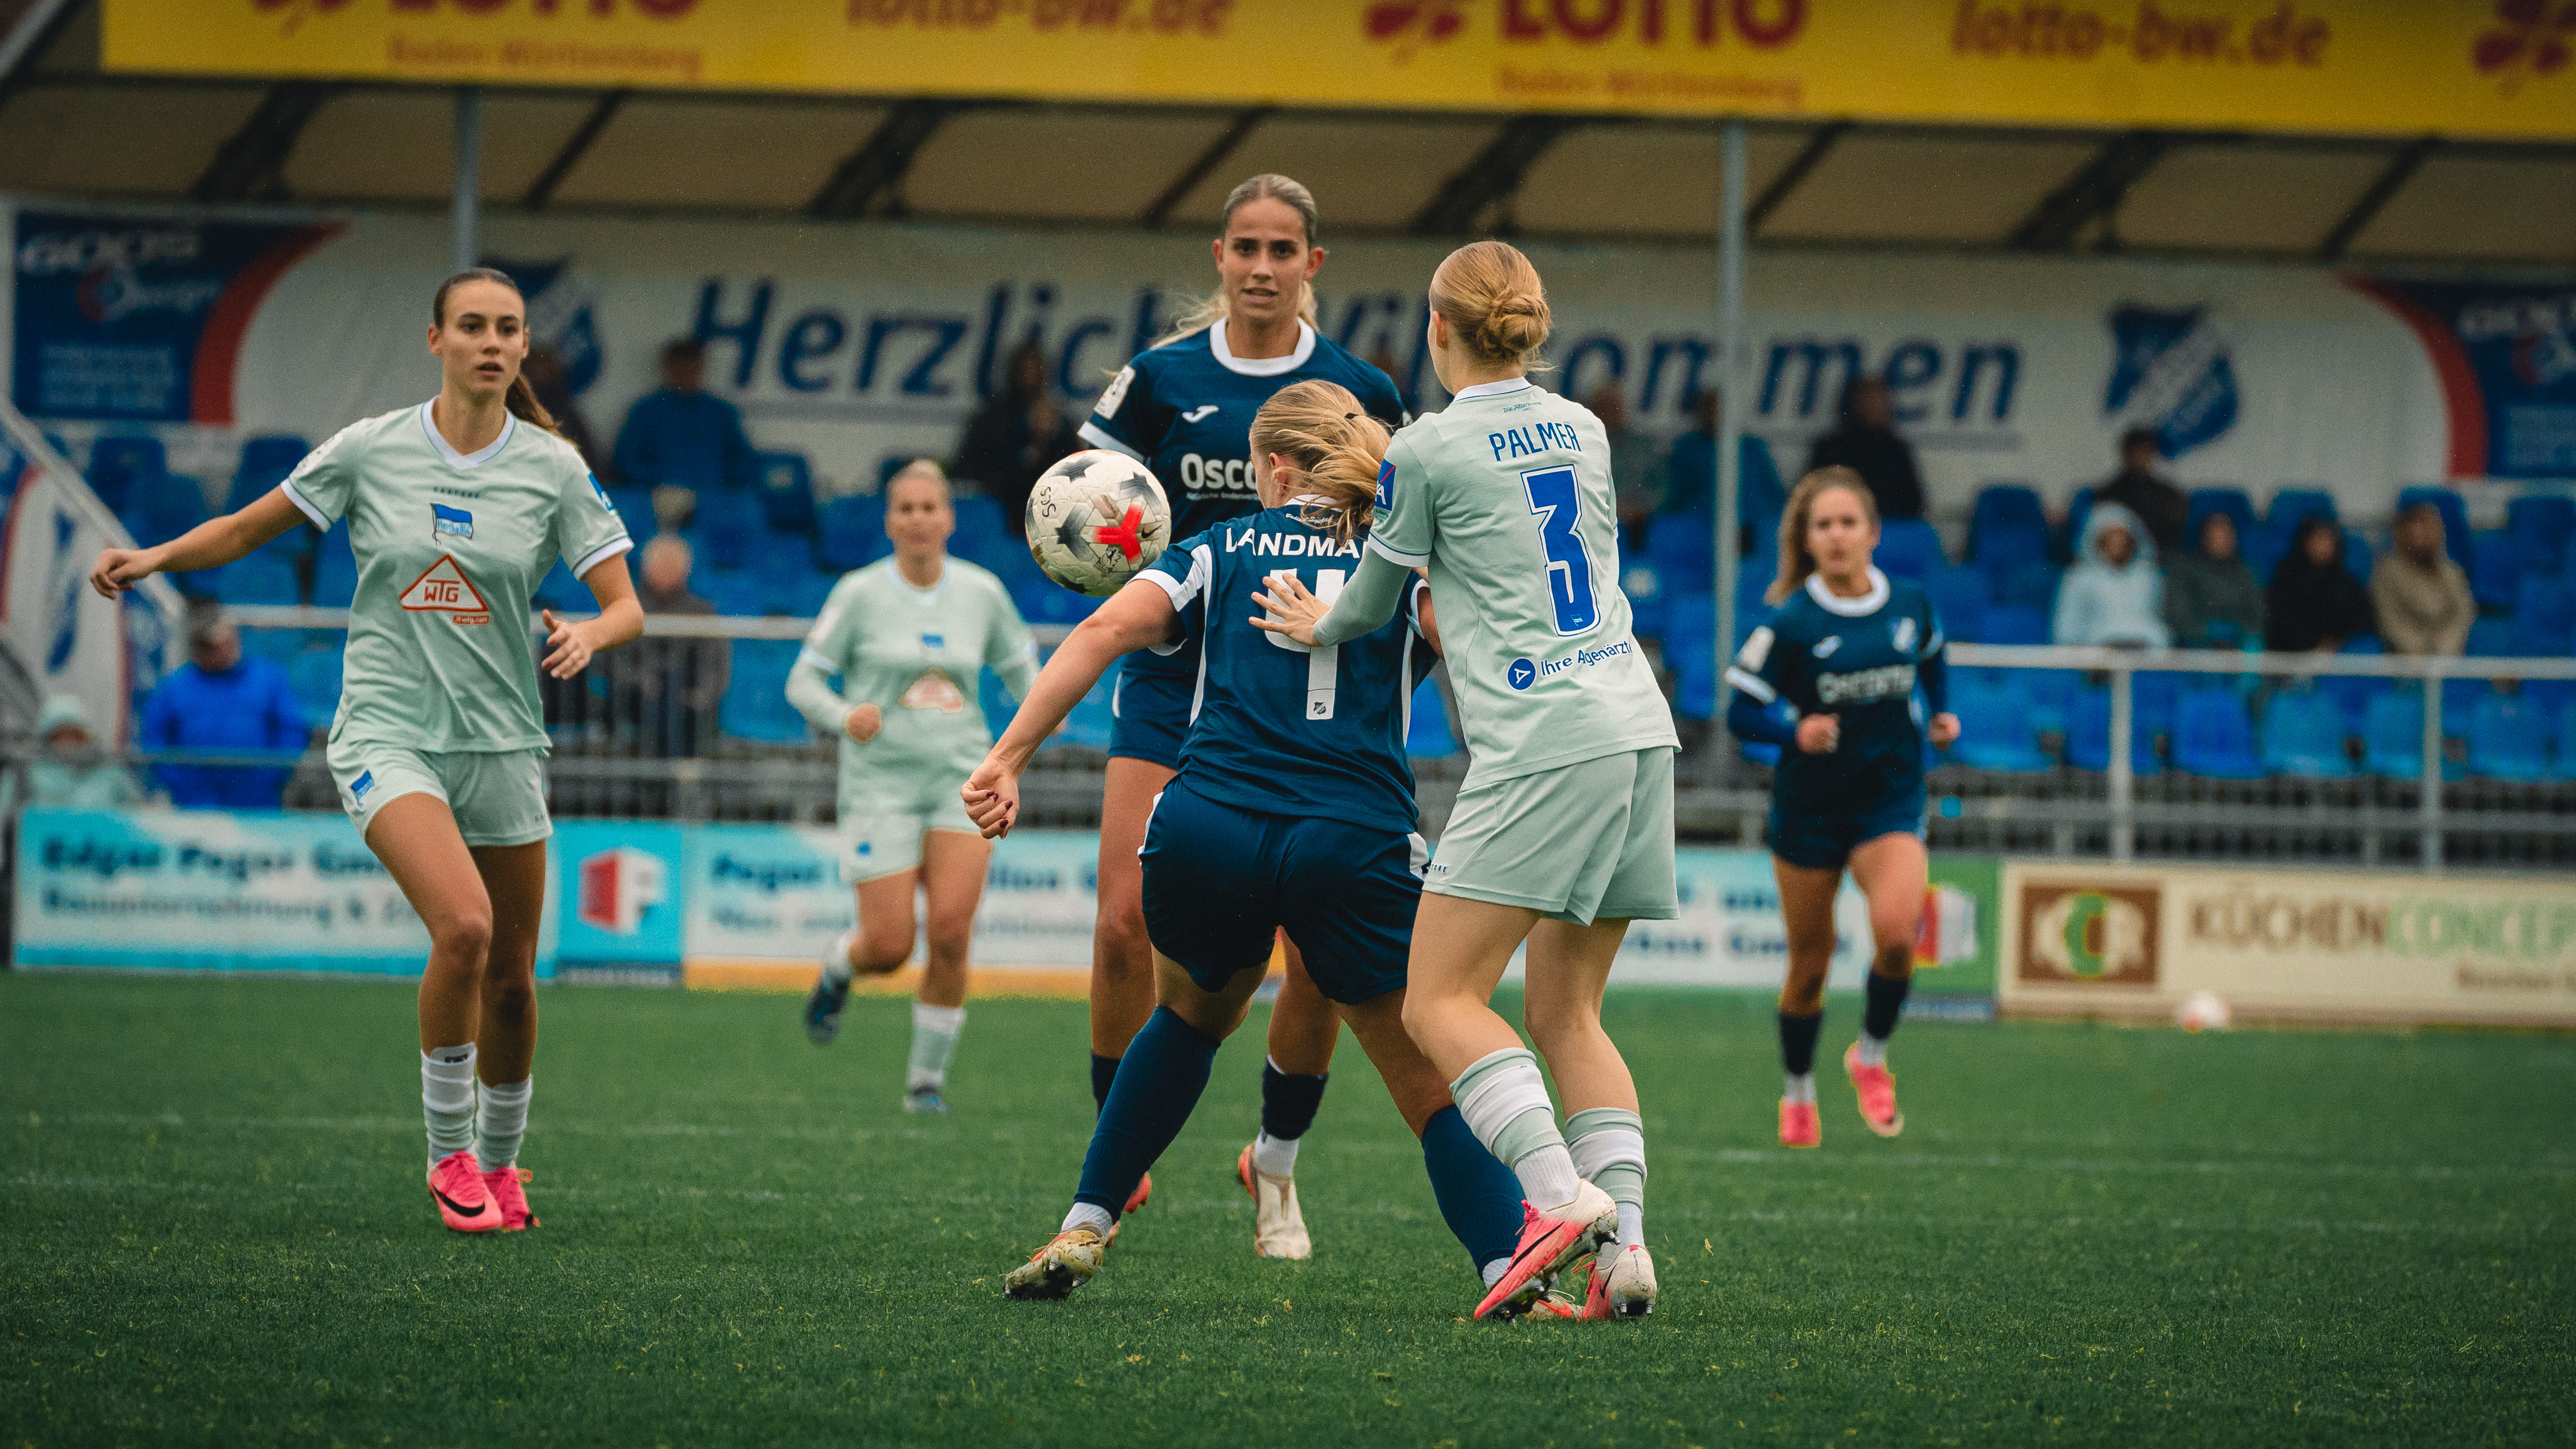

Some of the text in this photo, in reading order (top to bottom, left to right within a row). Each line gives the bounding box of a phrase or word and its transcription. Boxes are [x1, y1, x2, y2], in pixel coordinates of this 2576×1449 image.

[1488, 422, 1582, 462] PALMER
[1520, 463, 1601, 637] 3
[424, 578, 461, 603] WTG
[1264, 569, 1346, 721] 4
[1540, 657, 1573, 676] Ihre
